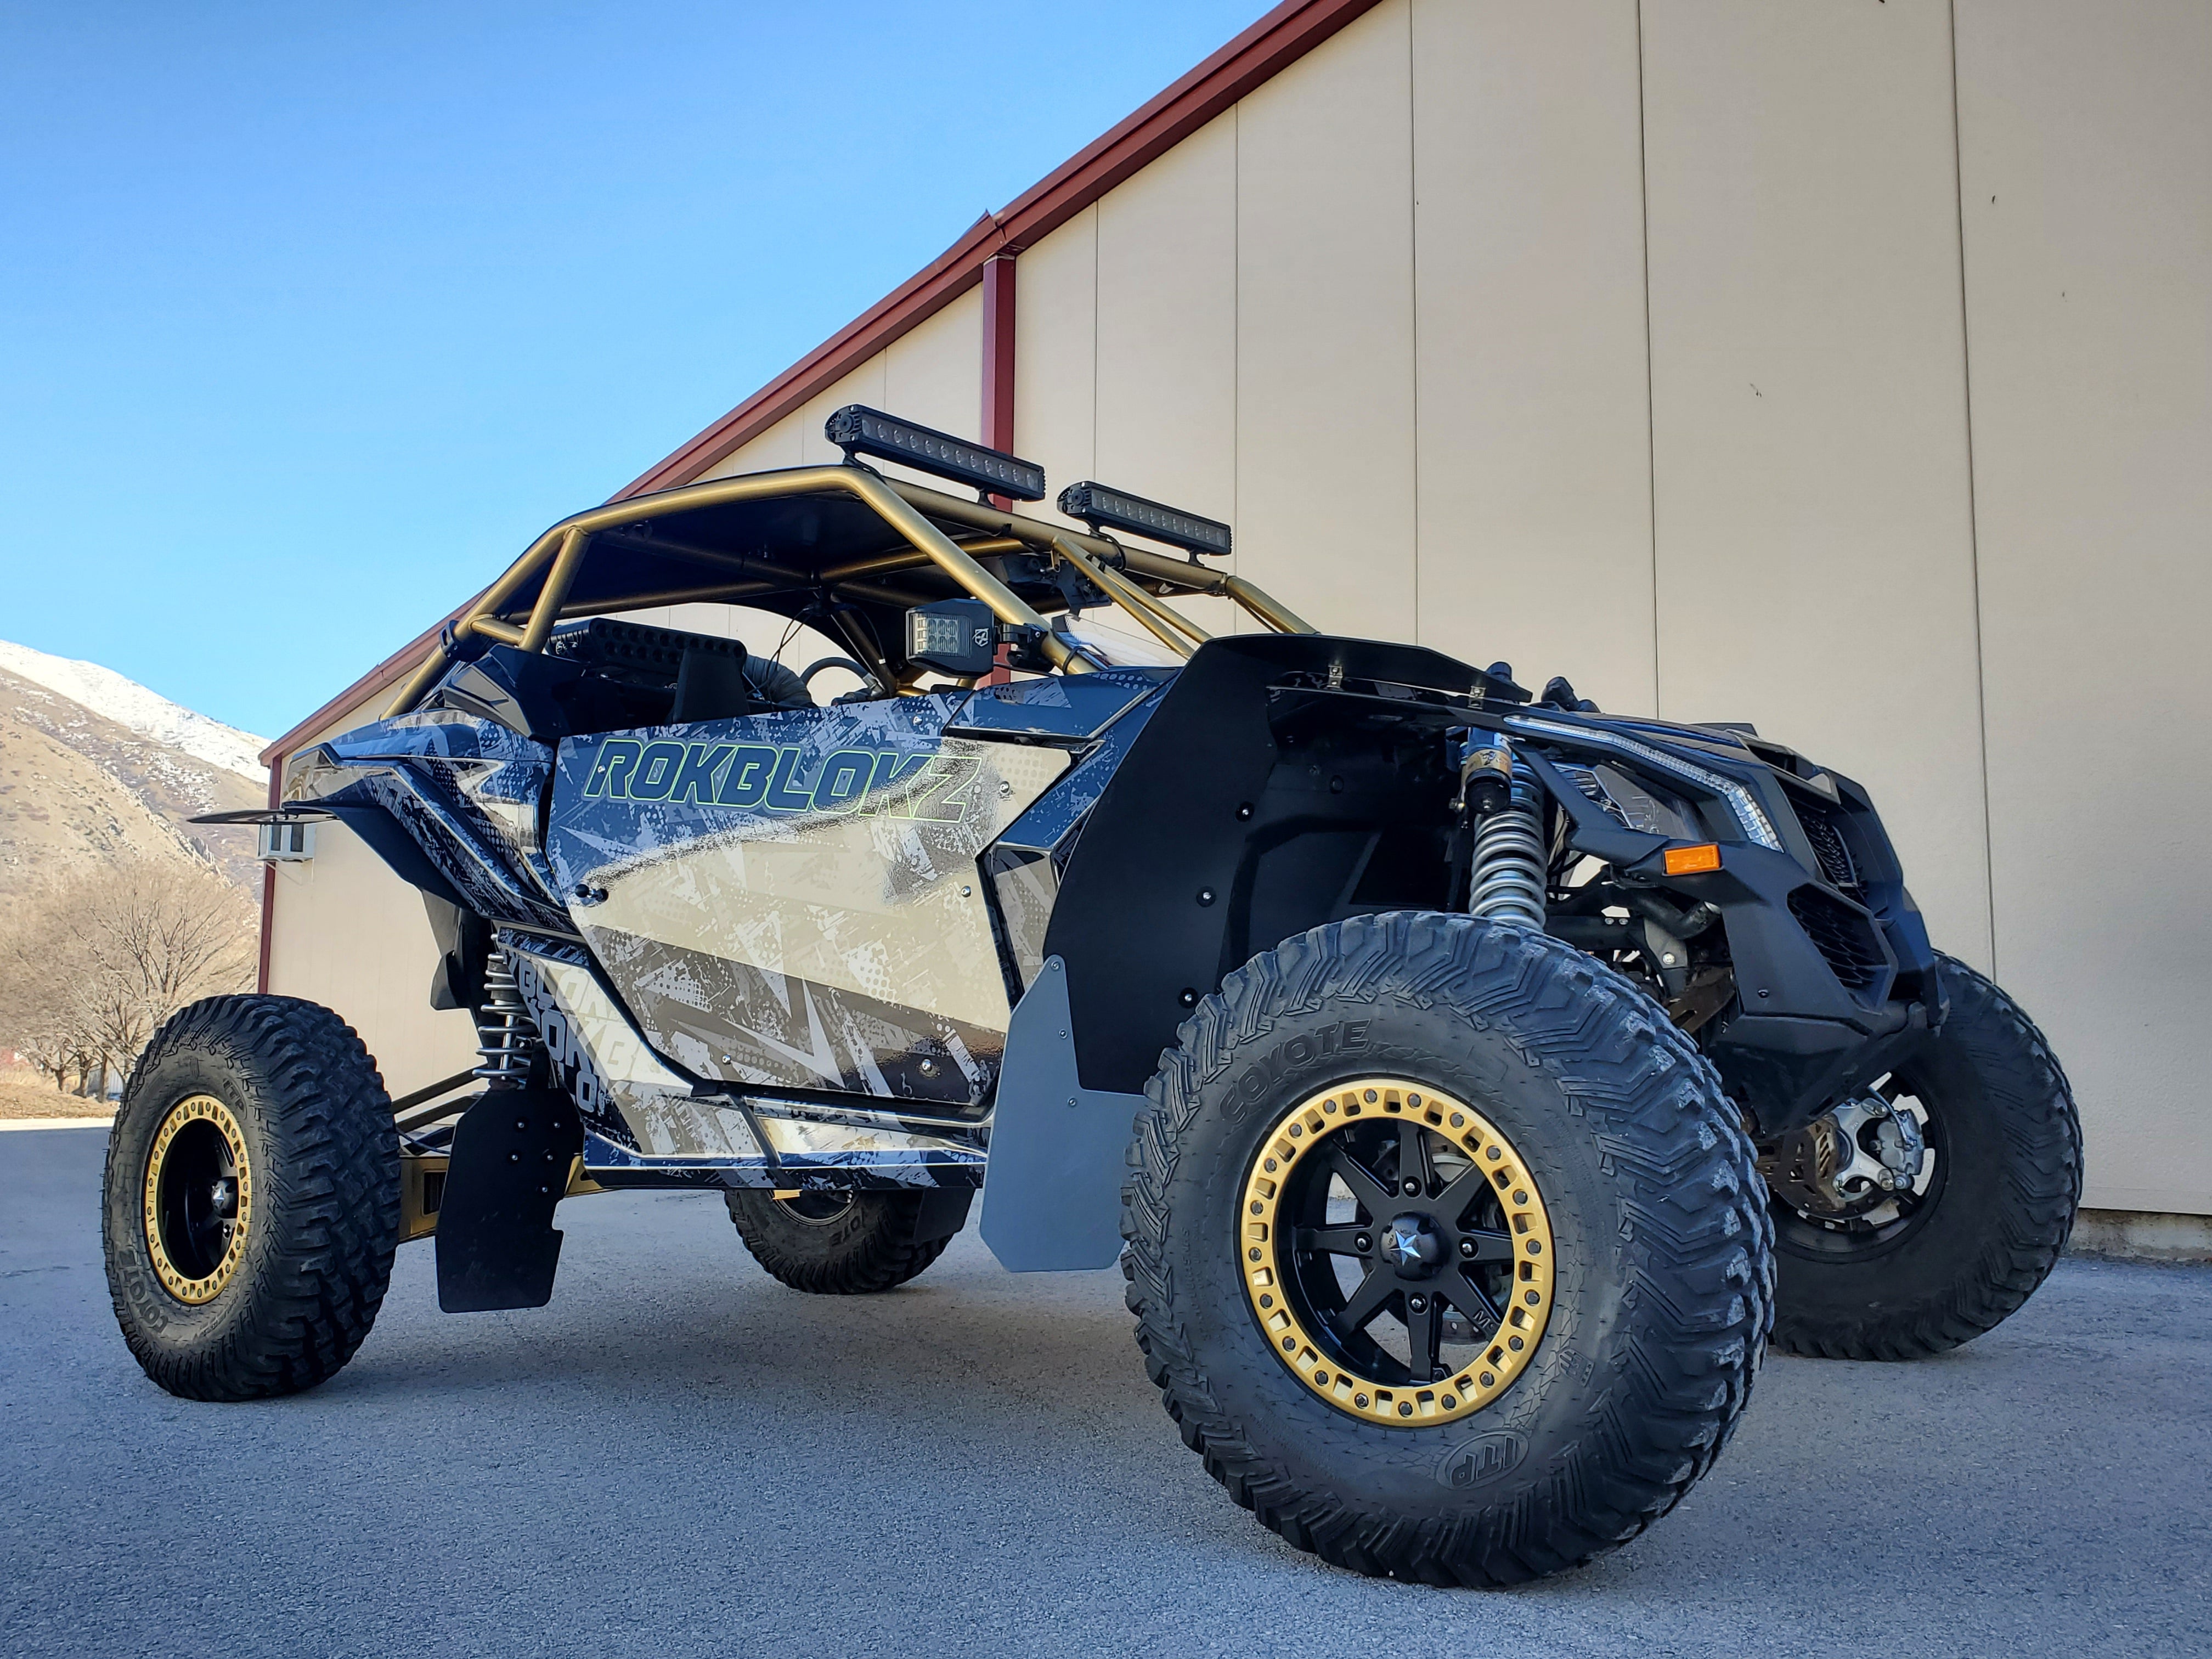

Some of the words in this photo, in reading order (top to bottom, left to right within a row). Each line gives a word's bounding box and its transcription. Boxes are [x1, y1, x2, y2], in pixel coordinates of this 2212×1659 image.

[583, 738, 983, 824] ROKBLOKZ
[223, 1078, 245, 1113] ITP
[1220, 1019, 1372, 1126] COYOTE
[120, 1250, 168, 1333] COYOTE
[1450, 1434, 1518, 1487] ITP
